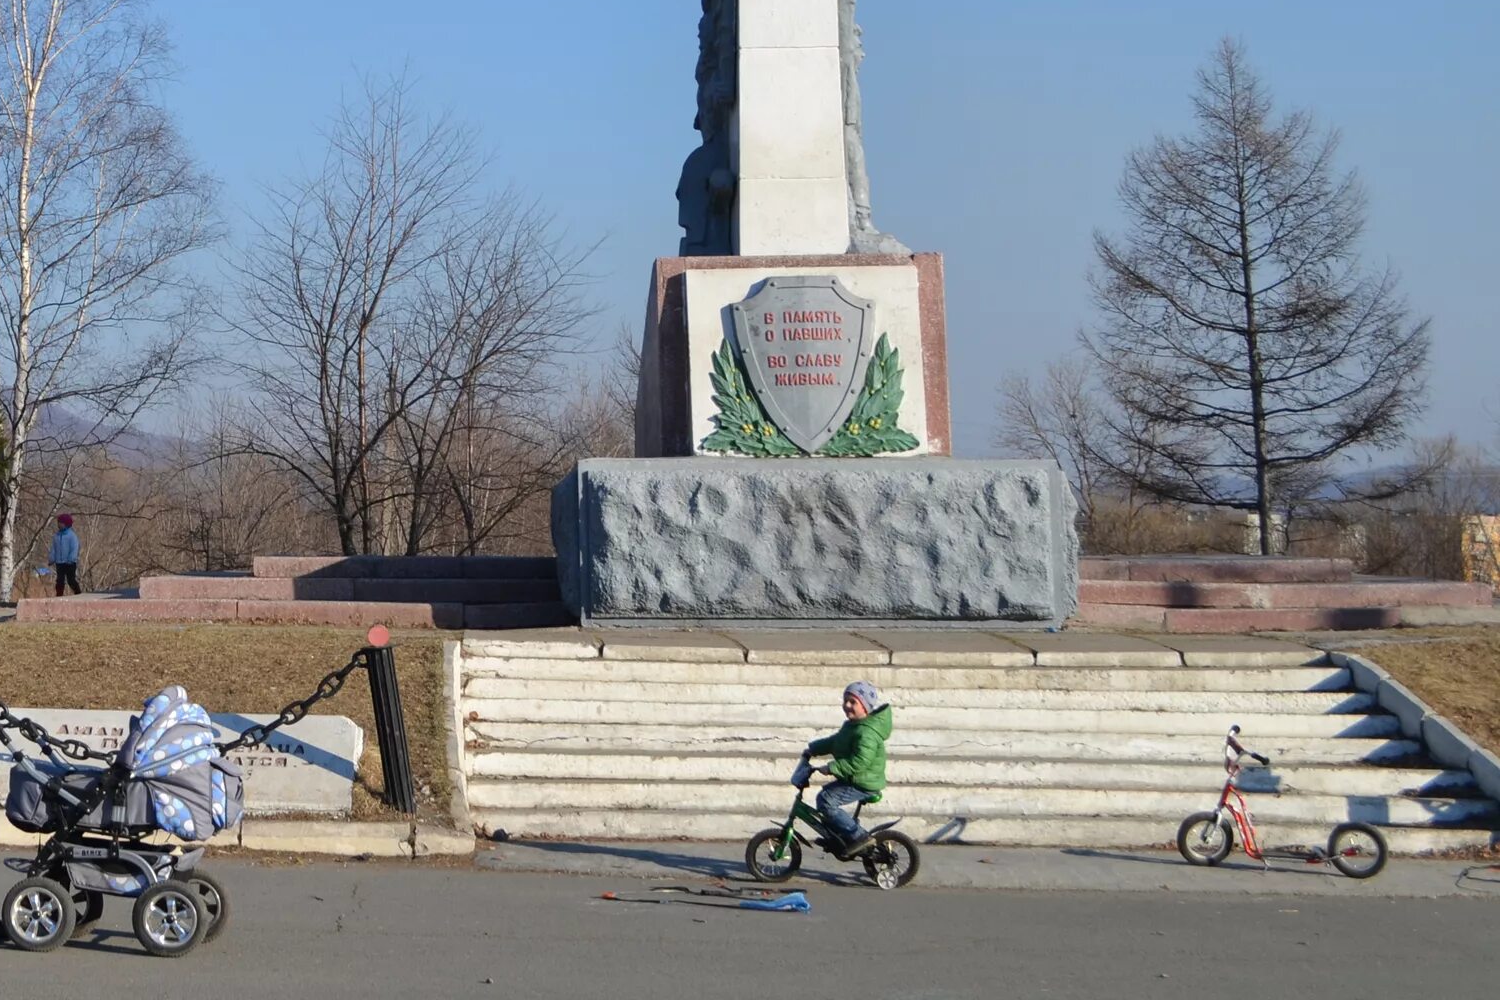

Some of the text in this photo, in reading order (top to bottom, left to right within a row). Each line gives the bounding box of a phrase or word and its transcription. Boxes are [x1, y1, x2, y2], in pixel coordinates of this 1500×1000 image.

[764, 310, 842, 325] В ПАМЯТЬ
[765, 327, 842, 342] О ПАВШИХ
[767, 353, 842, 368] ВО СЛАВУ
